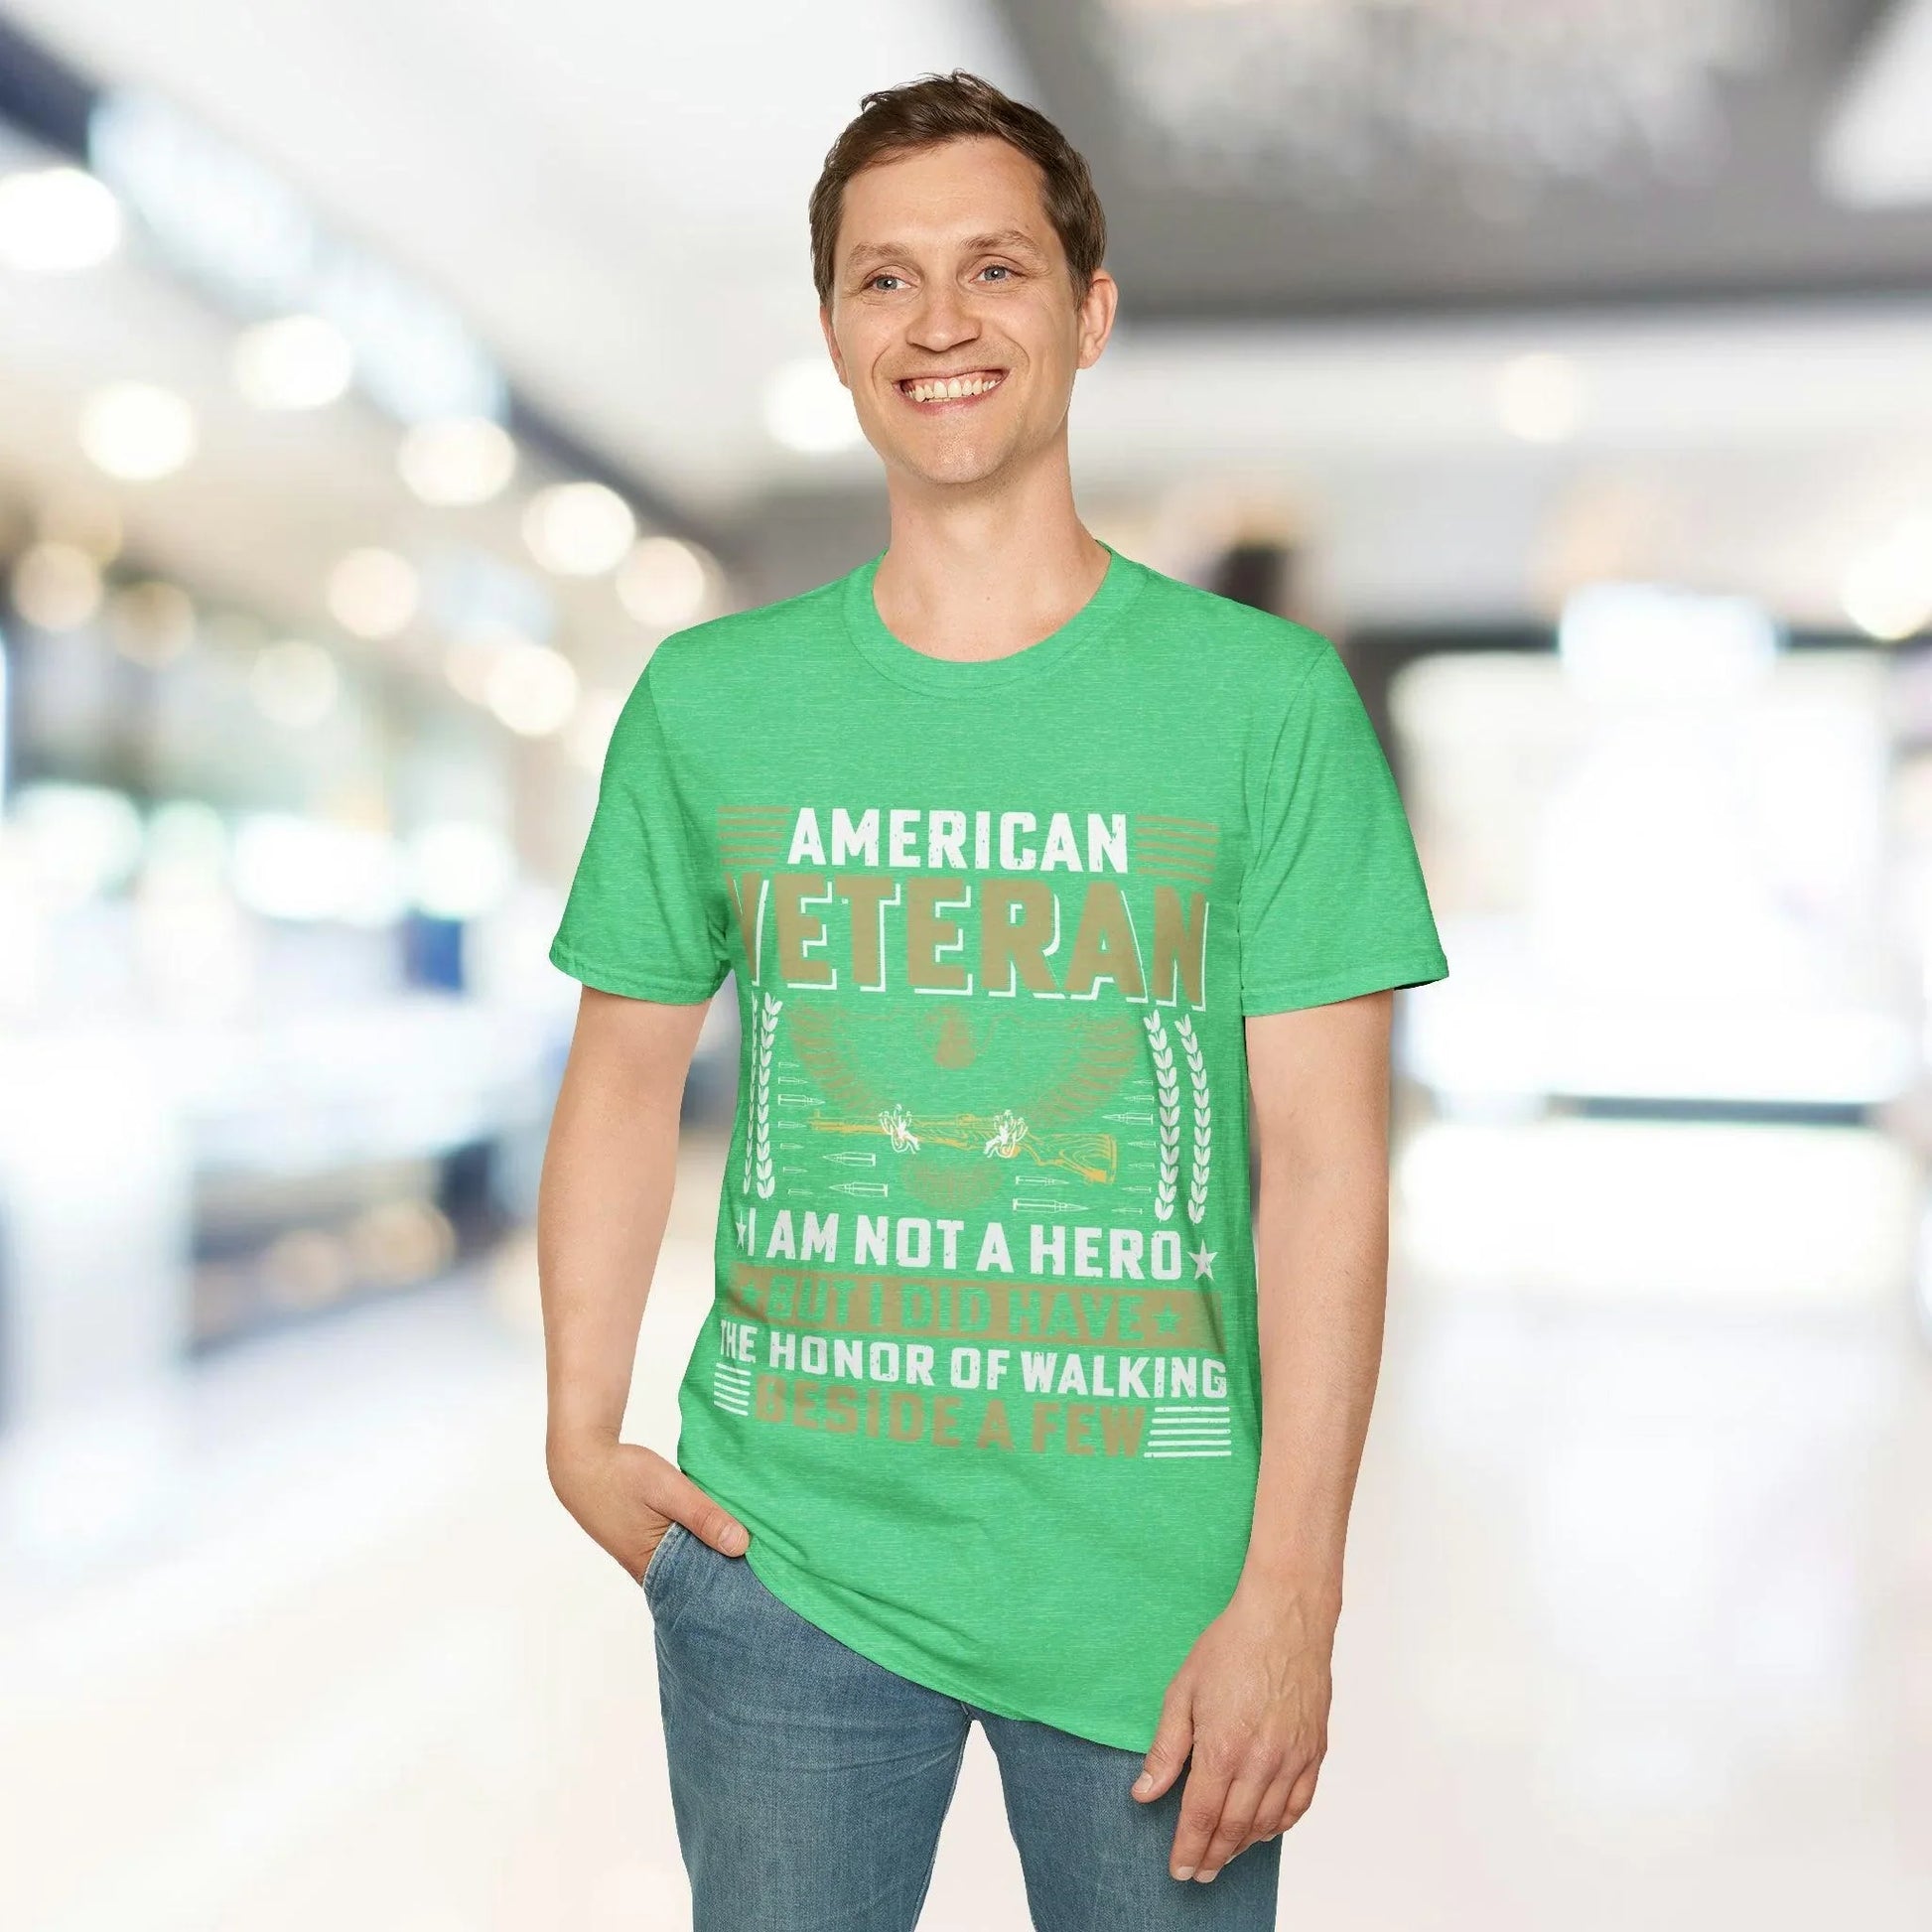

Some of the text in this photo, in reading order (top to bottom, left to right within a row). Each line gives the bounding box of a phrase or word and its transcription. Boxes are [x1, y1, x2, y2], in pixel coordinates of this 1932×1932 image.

[787, 808, 1128, 872] AMERICAN
[729, 873, 1209, 1011] VETERAN
[748, 1207, 1182, 1281] I AM NOT A HERO
[767, 1277, 1145, 1340] BUT I DID HAVE
[720, 1318, 1229, 1399] THE HONOR OF WALKING
[757, 1375, 1146, 1456] BESIDE A FEW
